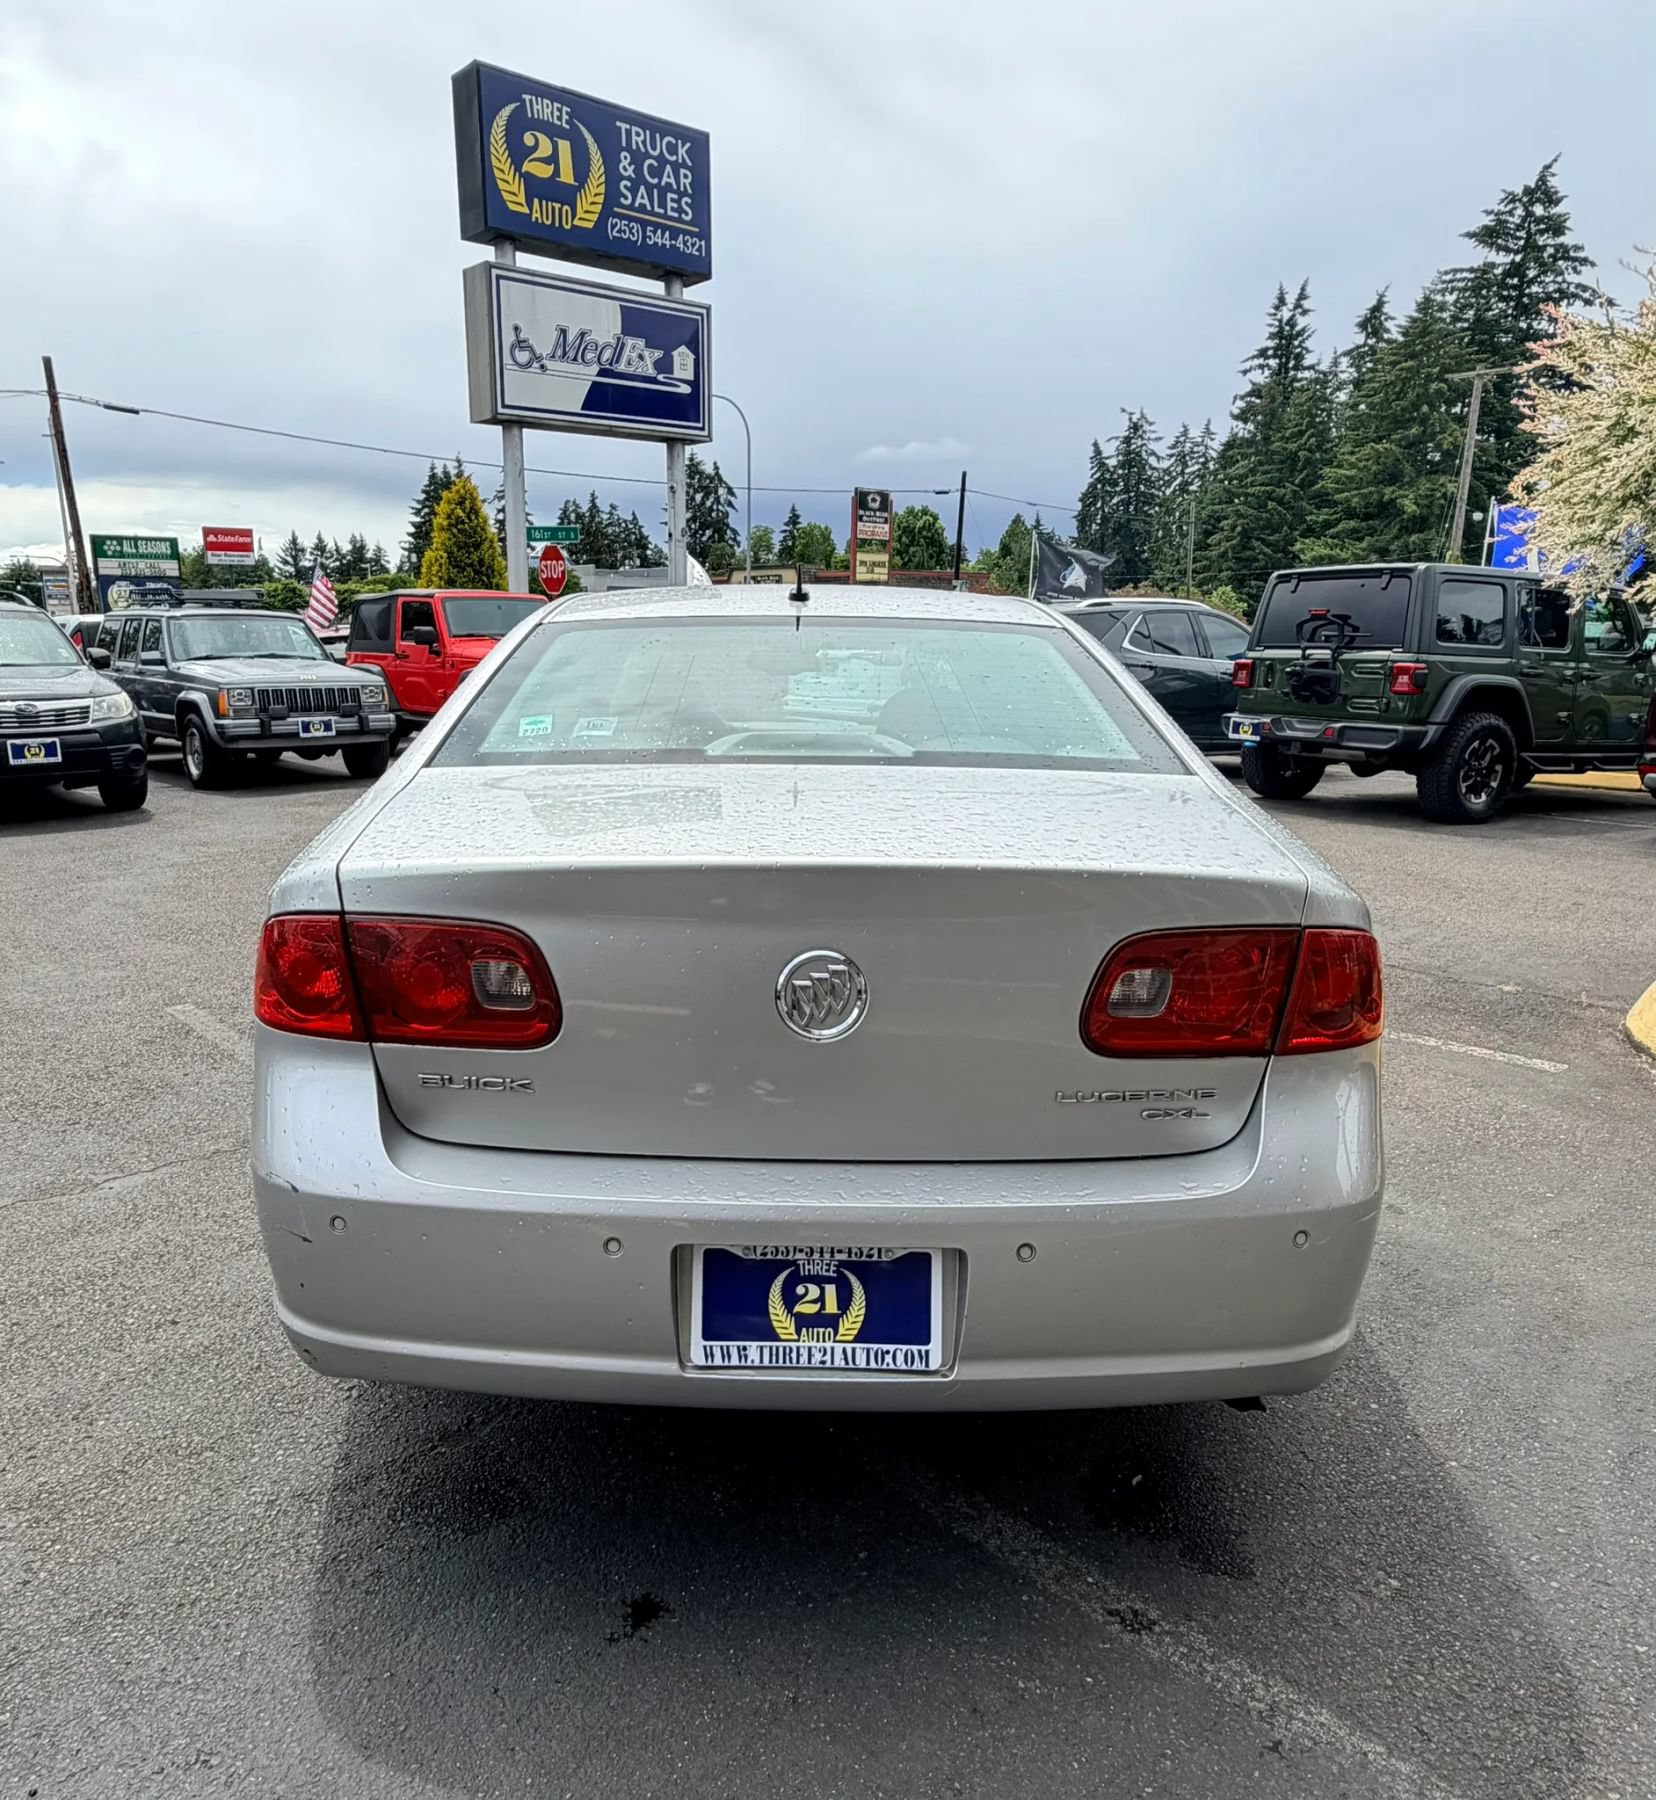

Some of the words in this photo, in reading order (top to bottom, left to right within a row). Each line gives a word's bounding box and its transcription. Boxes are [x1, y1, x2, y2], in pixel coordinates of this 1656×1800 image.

[522, 94, 571, 129] THREE
[522, 131, 578, 186] 21
[616, 121, 692, 166] TRUCK
[619, 151, 636, 178] &
[643, 159, 692, 194] CAR
[532, 198, 571, 229] AUTO
[620, 180, 693, 221] SALES
[608, 216, 642, 246] (253)
[646, 227, 706, 256] 544-4321
[546, 324, 664, 377] MedEx
[123, 540, 136, 554] ALL
[138, 540, 171, 555] SEASONS
[541, 560, 564, 579] STOP
[418, 1073, 535, 1093] BUICK
[1056, 1089, 1217, 1102] LUCERNE
[1141, 1107, 1212, 1120] CXL
[796, 1260, 839, 1277] THREE
[793, 1283, 841, 1315] 21
[800, 1327, 834, 1344] AUTO
